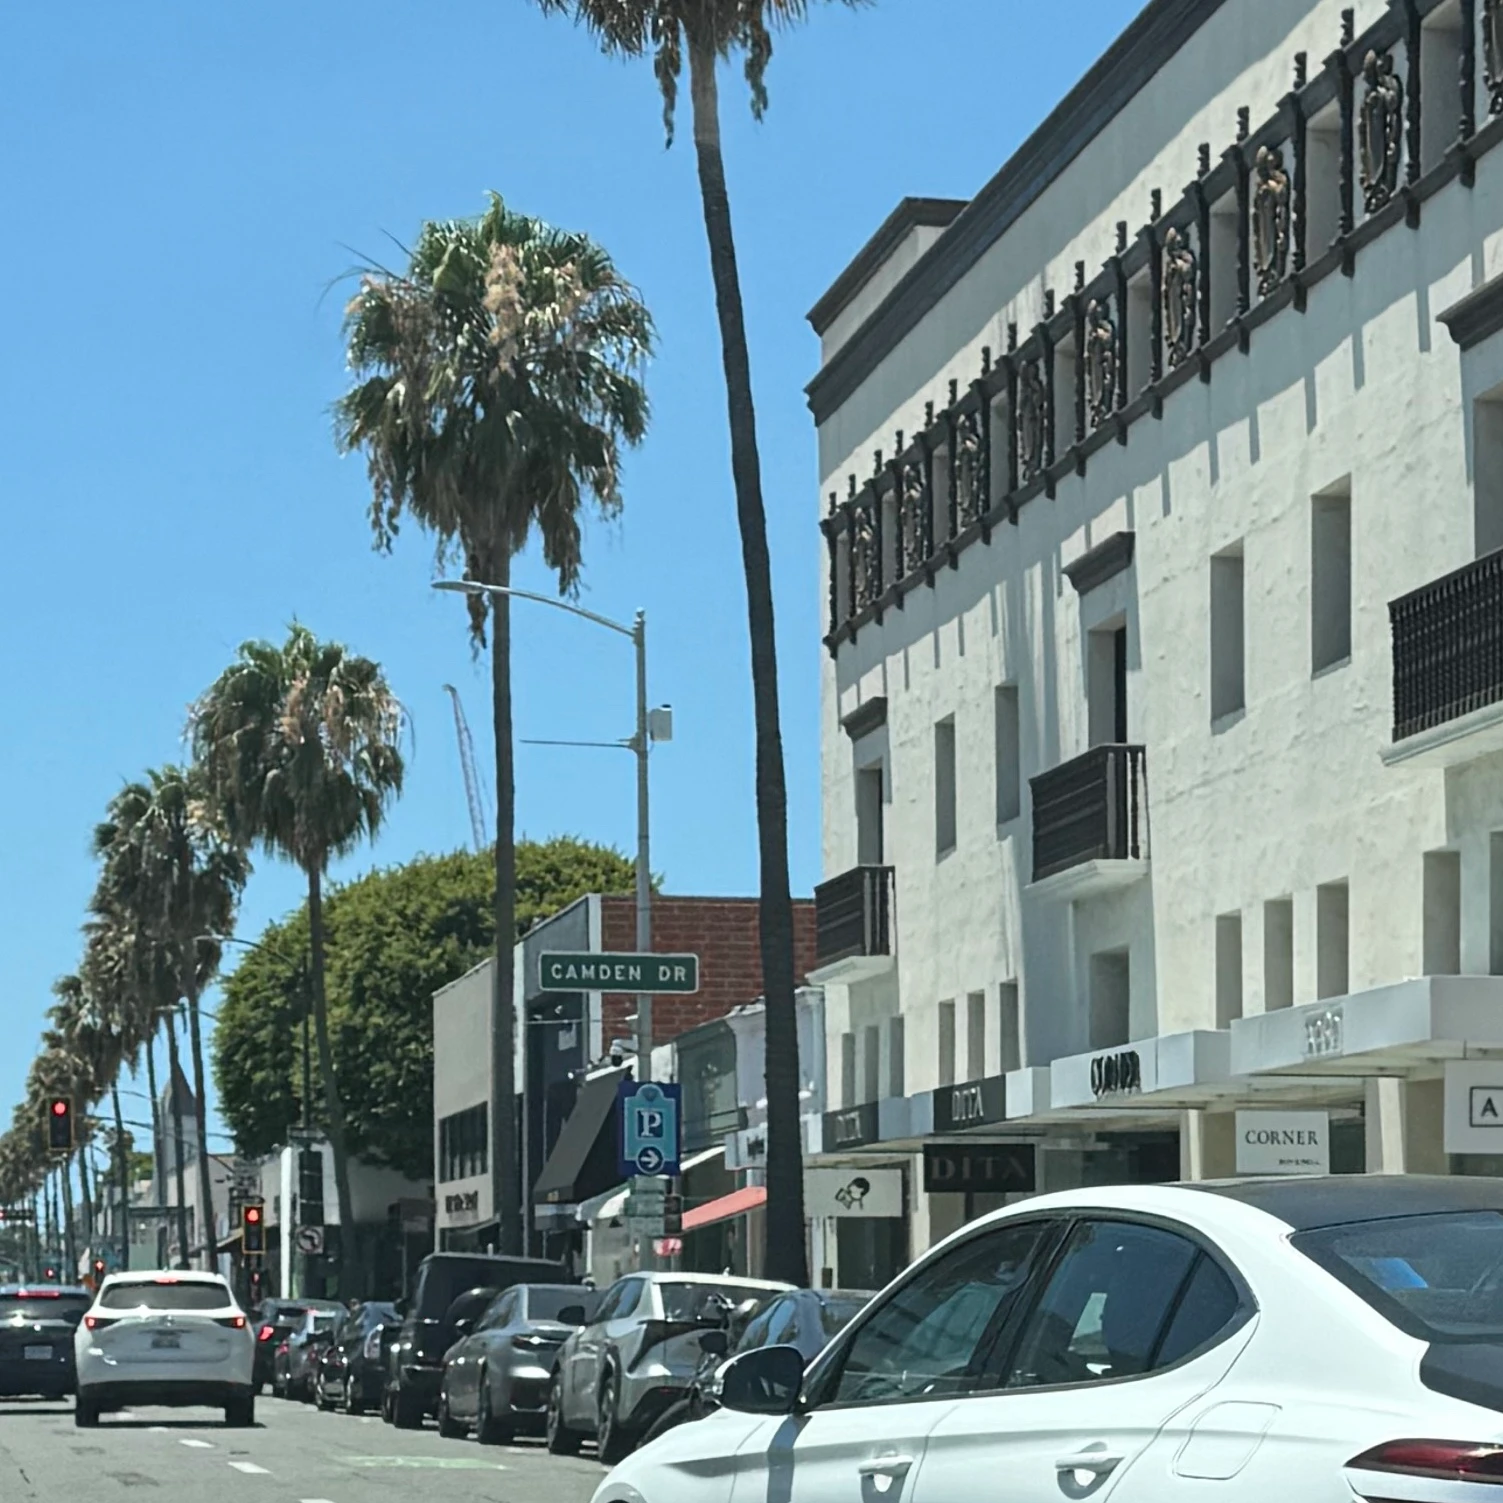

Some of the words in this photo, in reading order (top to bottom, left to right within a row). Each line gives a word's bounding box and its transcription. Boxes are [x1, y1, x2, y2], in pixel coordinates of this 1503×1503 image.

[551, 964, 641, 981] CAMDEN
[658, 965, 686, 981] DR
[640, 1110, 662, 1137] P
[1245, 1130, 1318, 1145] CORNER
[931, 1156, 1026, 1180] DITA
